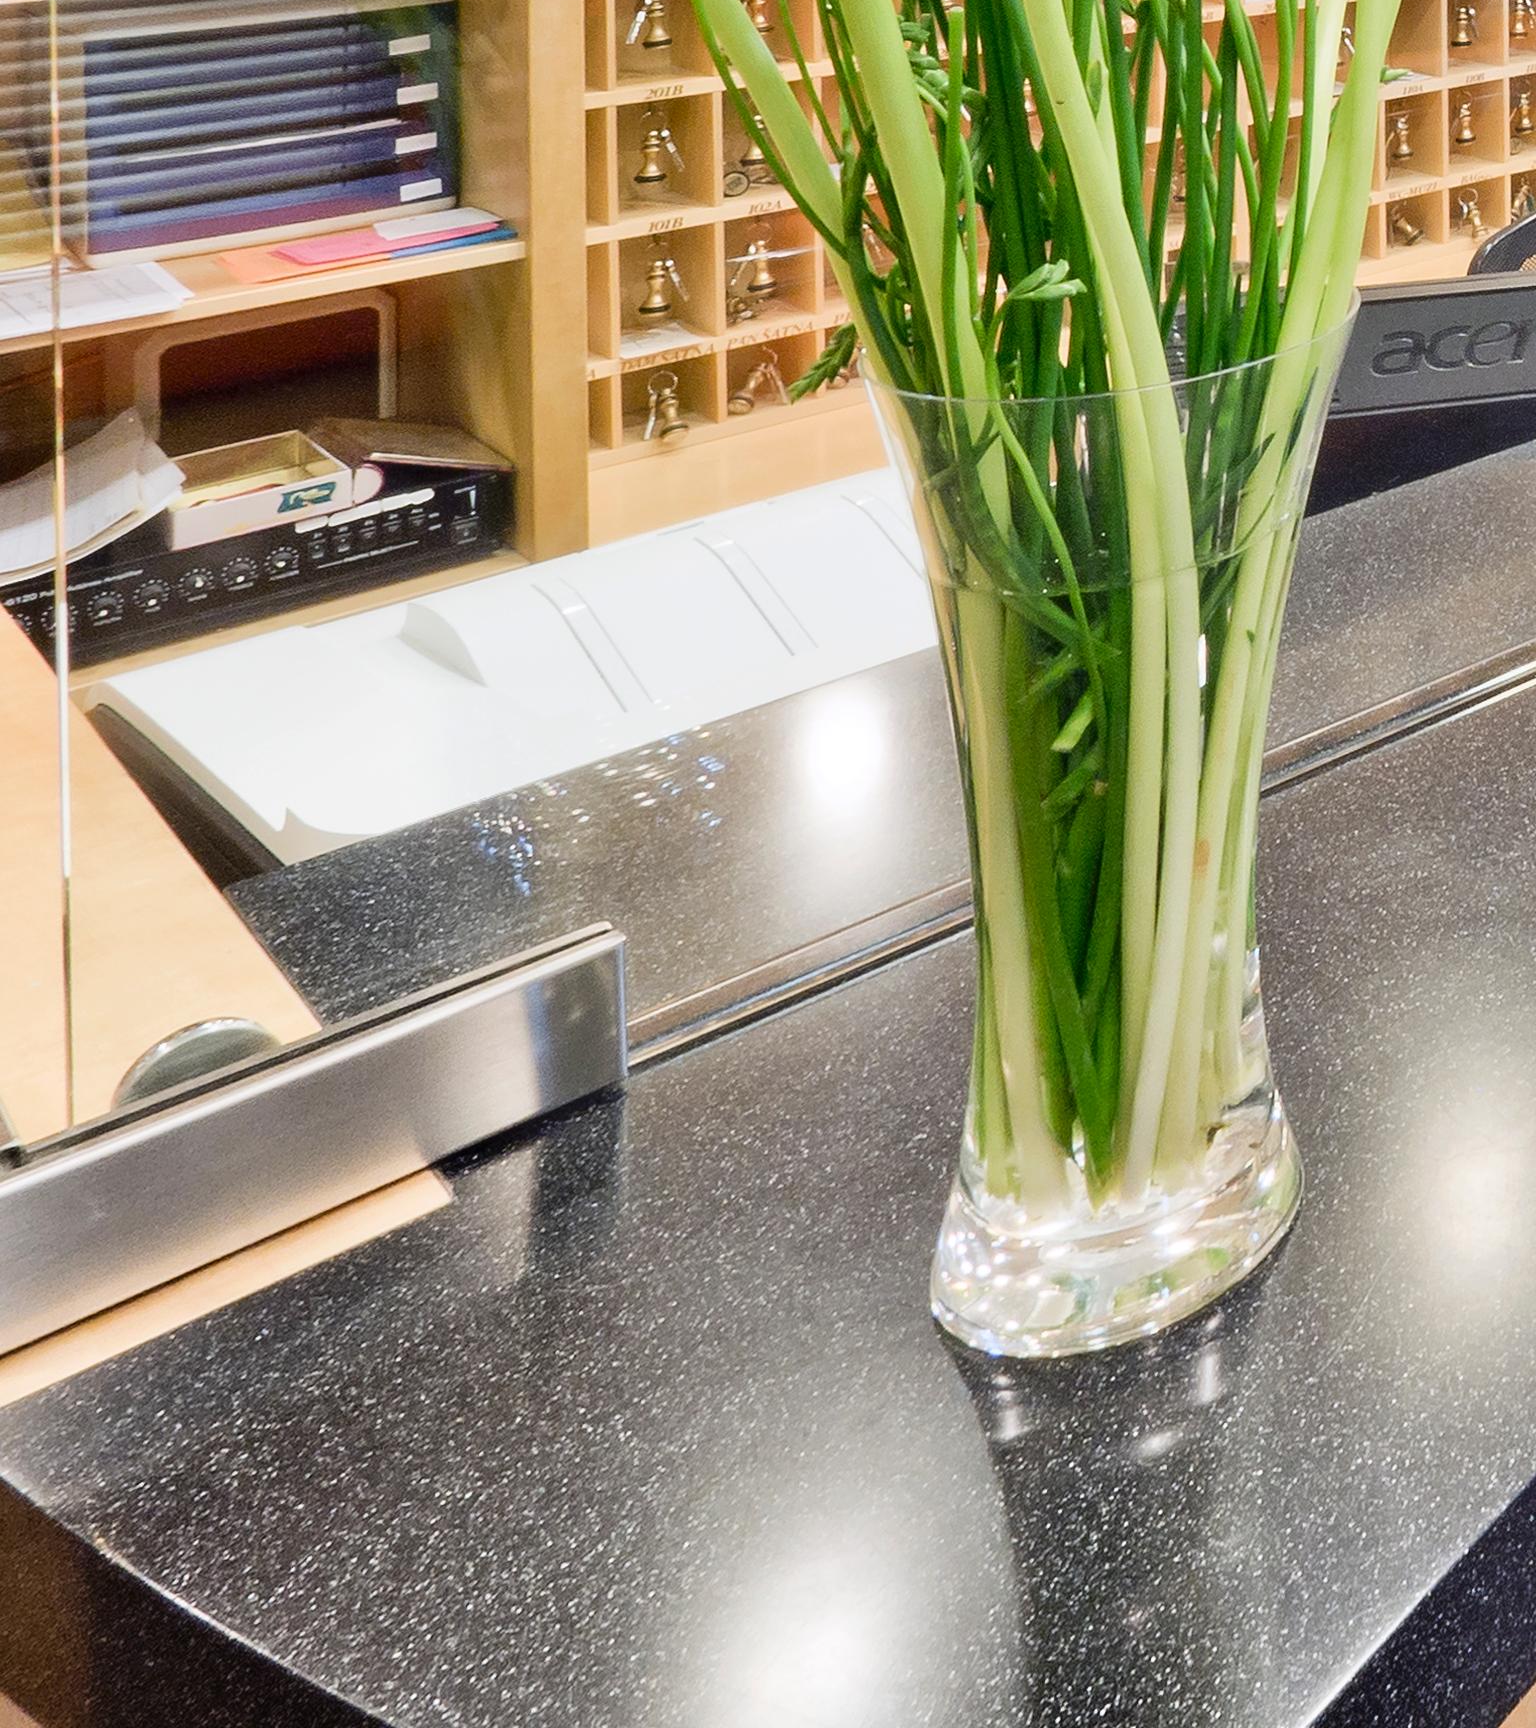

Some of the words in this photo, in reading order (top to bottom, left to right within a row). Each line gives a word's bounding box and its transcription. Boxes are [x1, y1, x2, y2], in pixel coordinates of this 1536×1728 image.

[645, 84, 684, 100] 201B
[748, 200, 782, 214] 102A
[648, 217, 684, 233] 101B
